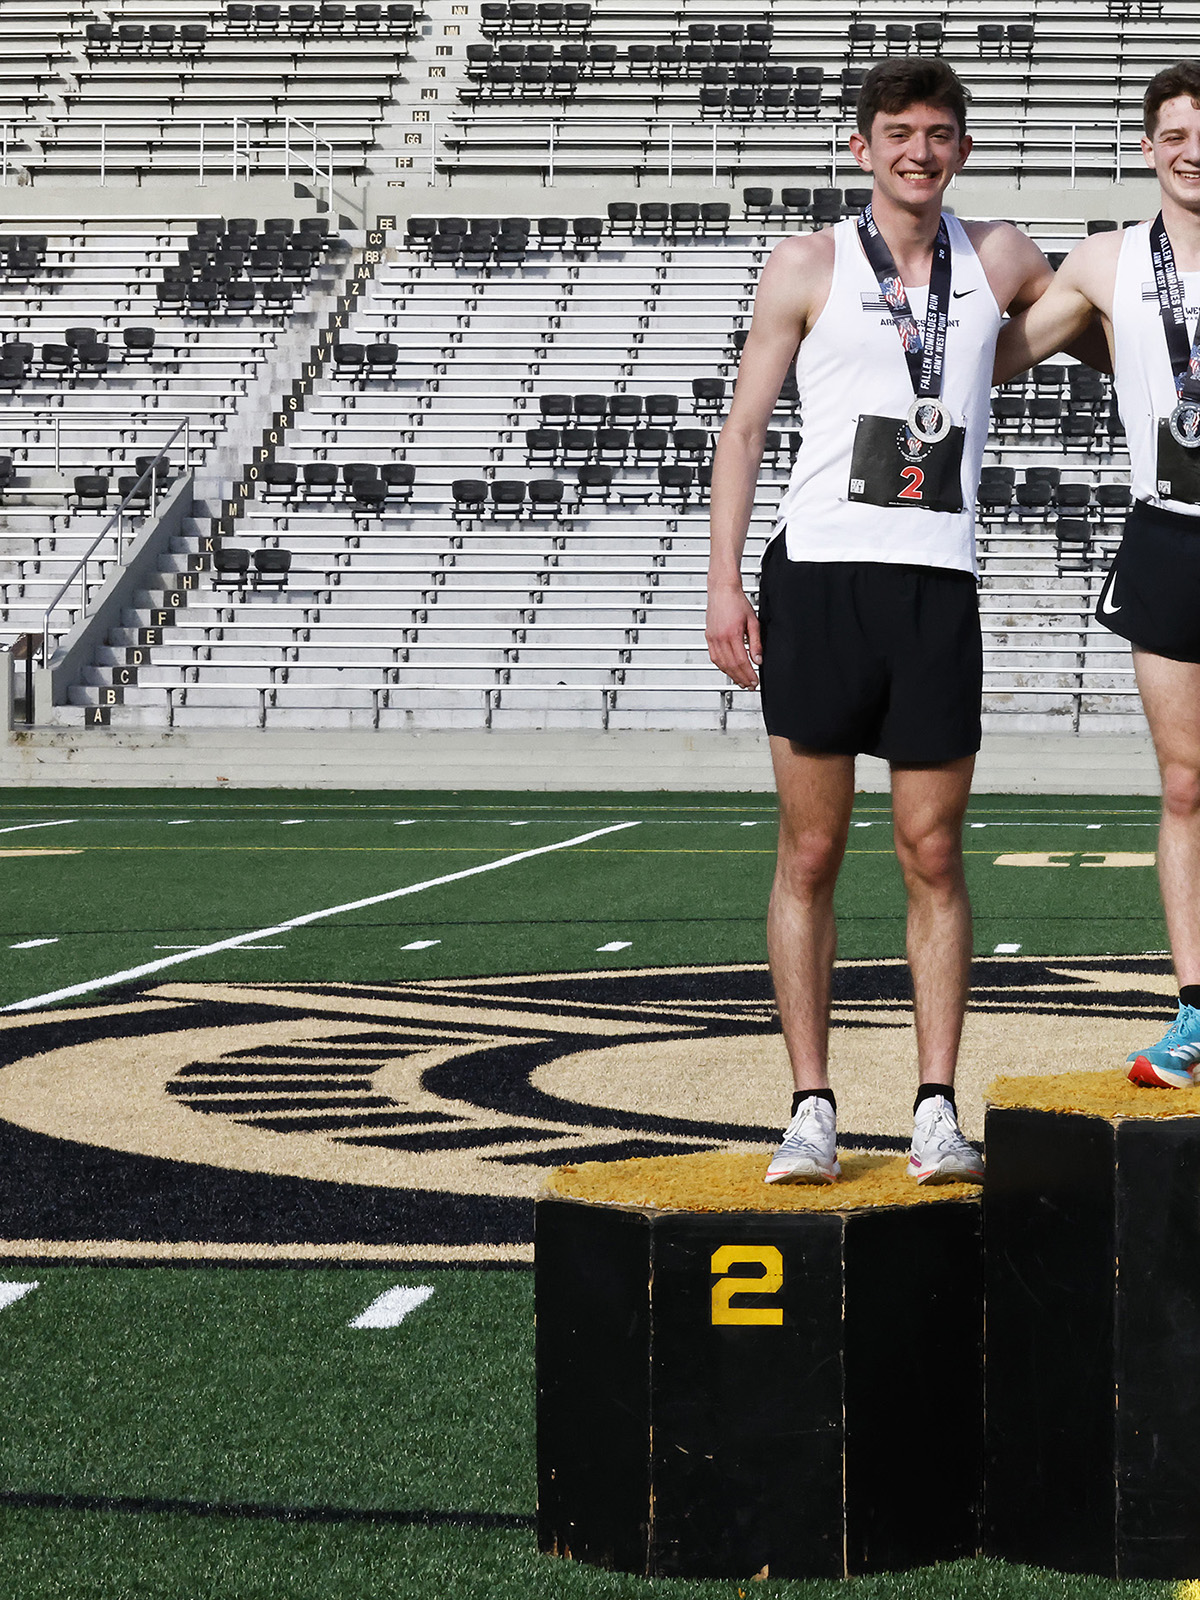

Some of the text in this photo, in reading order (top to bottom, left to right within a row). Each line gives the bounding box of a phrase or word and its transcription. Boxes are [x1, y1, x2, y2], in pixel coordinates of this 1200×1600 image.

[430, 68, 443, 77] KK
[423, 90, 436, 99] JJ
[414, 112, 427, 121] HH
[406, 134, 420, 144] GG
[379, 219, 392, 230] EE
[369, 234, 382, 244] CC
[366, 251, 379, 262] BB
[357, 268, 370, 279] AA
[1158, 232, 1184, 325] FALLEN COMRADES RUN
[1153, 252, 1170, 309] ARMY WEST POINT
[352, 283, 359, 294] Z
[343, 300, 350, 310] Y
[335, 316, 342, 327] X
[325, 332, 333, 343] W
[920, 293, 939, 390] FALLEN COMRADES RUN
[933, 312, 946, 375] ARMY WEST POINT
[317, 349, 325, 360] V
[308, 366, 316, 377] U
[299, 382, 306, 393] T
[289, 398, 297, 410] S
[280, 415, 287, 427] R
[269, 432, 277, 444] Q
[260, 450, 268, 462] P
[250, 467, 258, 480] O
[897, 465, 925, 500] 2
[240, 484, 248, 497] N
[229, 503, 237, 516] M
[218, 521, 226, 534] L
[205, 538, 214, 551] K
[195, 558, 203, 570] J
[183, 575, 192, 589] H
[171, 593, 180, 606] G
[158, 612, 167, 625] F
[146, 630, 155, 644] E
[133, 651, 143, 664] D
[120, 670, 129, 683] C
[107, 690, 116, 704] B
[94, 708, 102, 722] A
[710, 1244, 783, 1326] 2
